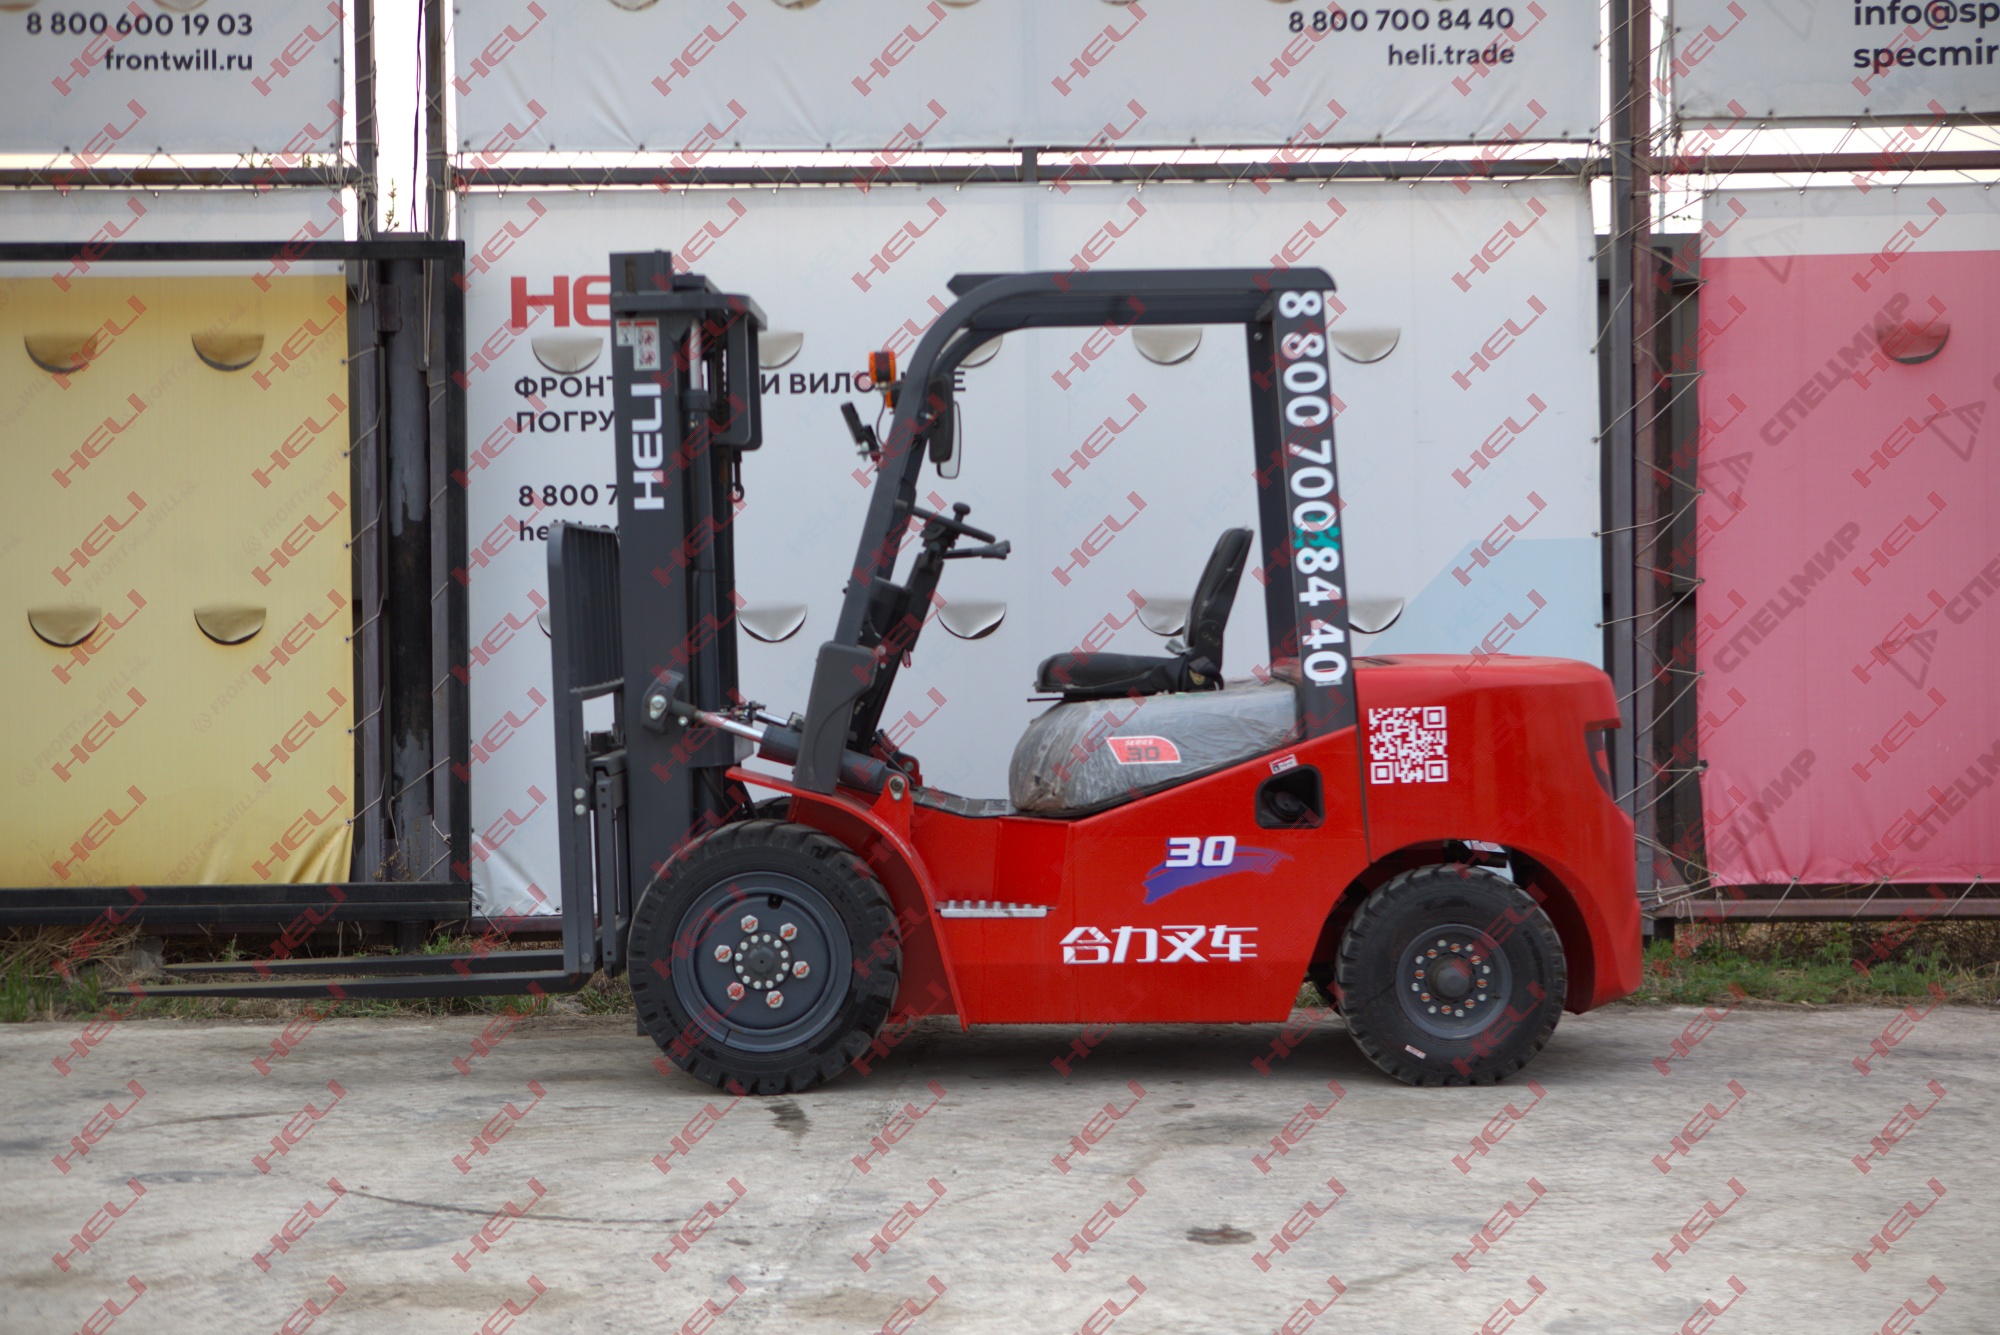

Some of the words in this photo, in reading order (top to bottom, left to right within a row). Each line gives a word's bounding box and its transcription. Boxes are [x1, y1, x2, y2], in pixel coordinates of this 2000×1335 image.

[26, 12, 42, 35] 8
[51, 12, 108, 35] 800
[116, 13, 173, 36] 600
[181, 14, 209, 36] 19
[217, 14, 253, 36] 03
[1289, 11, 1303, 32] 8
[1312, 9, 1368, 32] 800
[1375, 8, 1429, 31] 700
[1437, 7, 1471, 31] 84
[1478, 6, 1514, 30] 40
[105, 48, 252, 71] frontwill.ru
[1388, 43, 1514, 66] heli.trade
[1854, 37, 1999, 74] specmir
[1279, 290, 1322, 318] 8
[1281, 332, 1330, 427] 800
[1759, 292, 1910, 446] СПЕЦМИР
[631, 383, 664, 510] HELI
[519, 485, 534, 506] 8
[543, 484, 598, 506] 800
[1288, 439, 1337, 532] 700
[1296, 547, 1341, 606] 84
[1712, 521, 1861, 674] СПЕЦМИР
[1302, 619, 1347, 682] 40
[1126, 746, 1160, 761] 30
[1165, 836, 1236, 867] 30
[1059, 925, 1258, 964] 合力叉车
